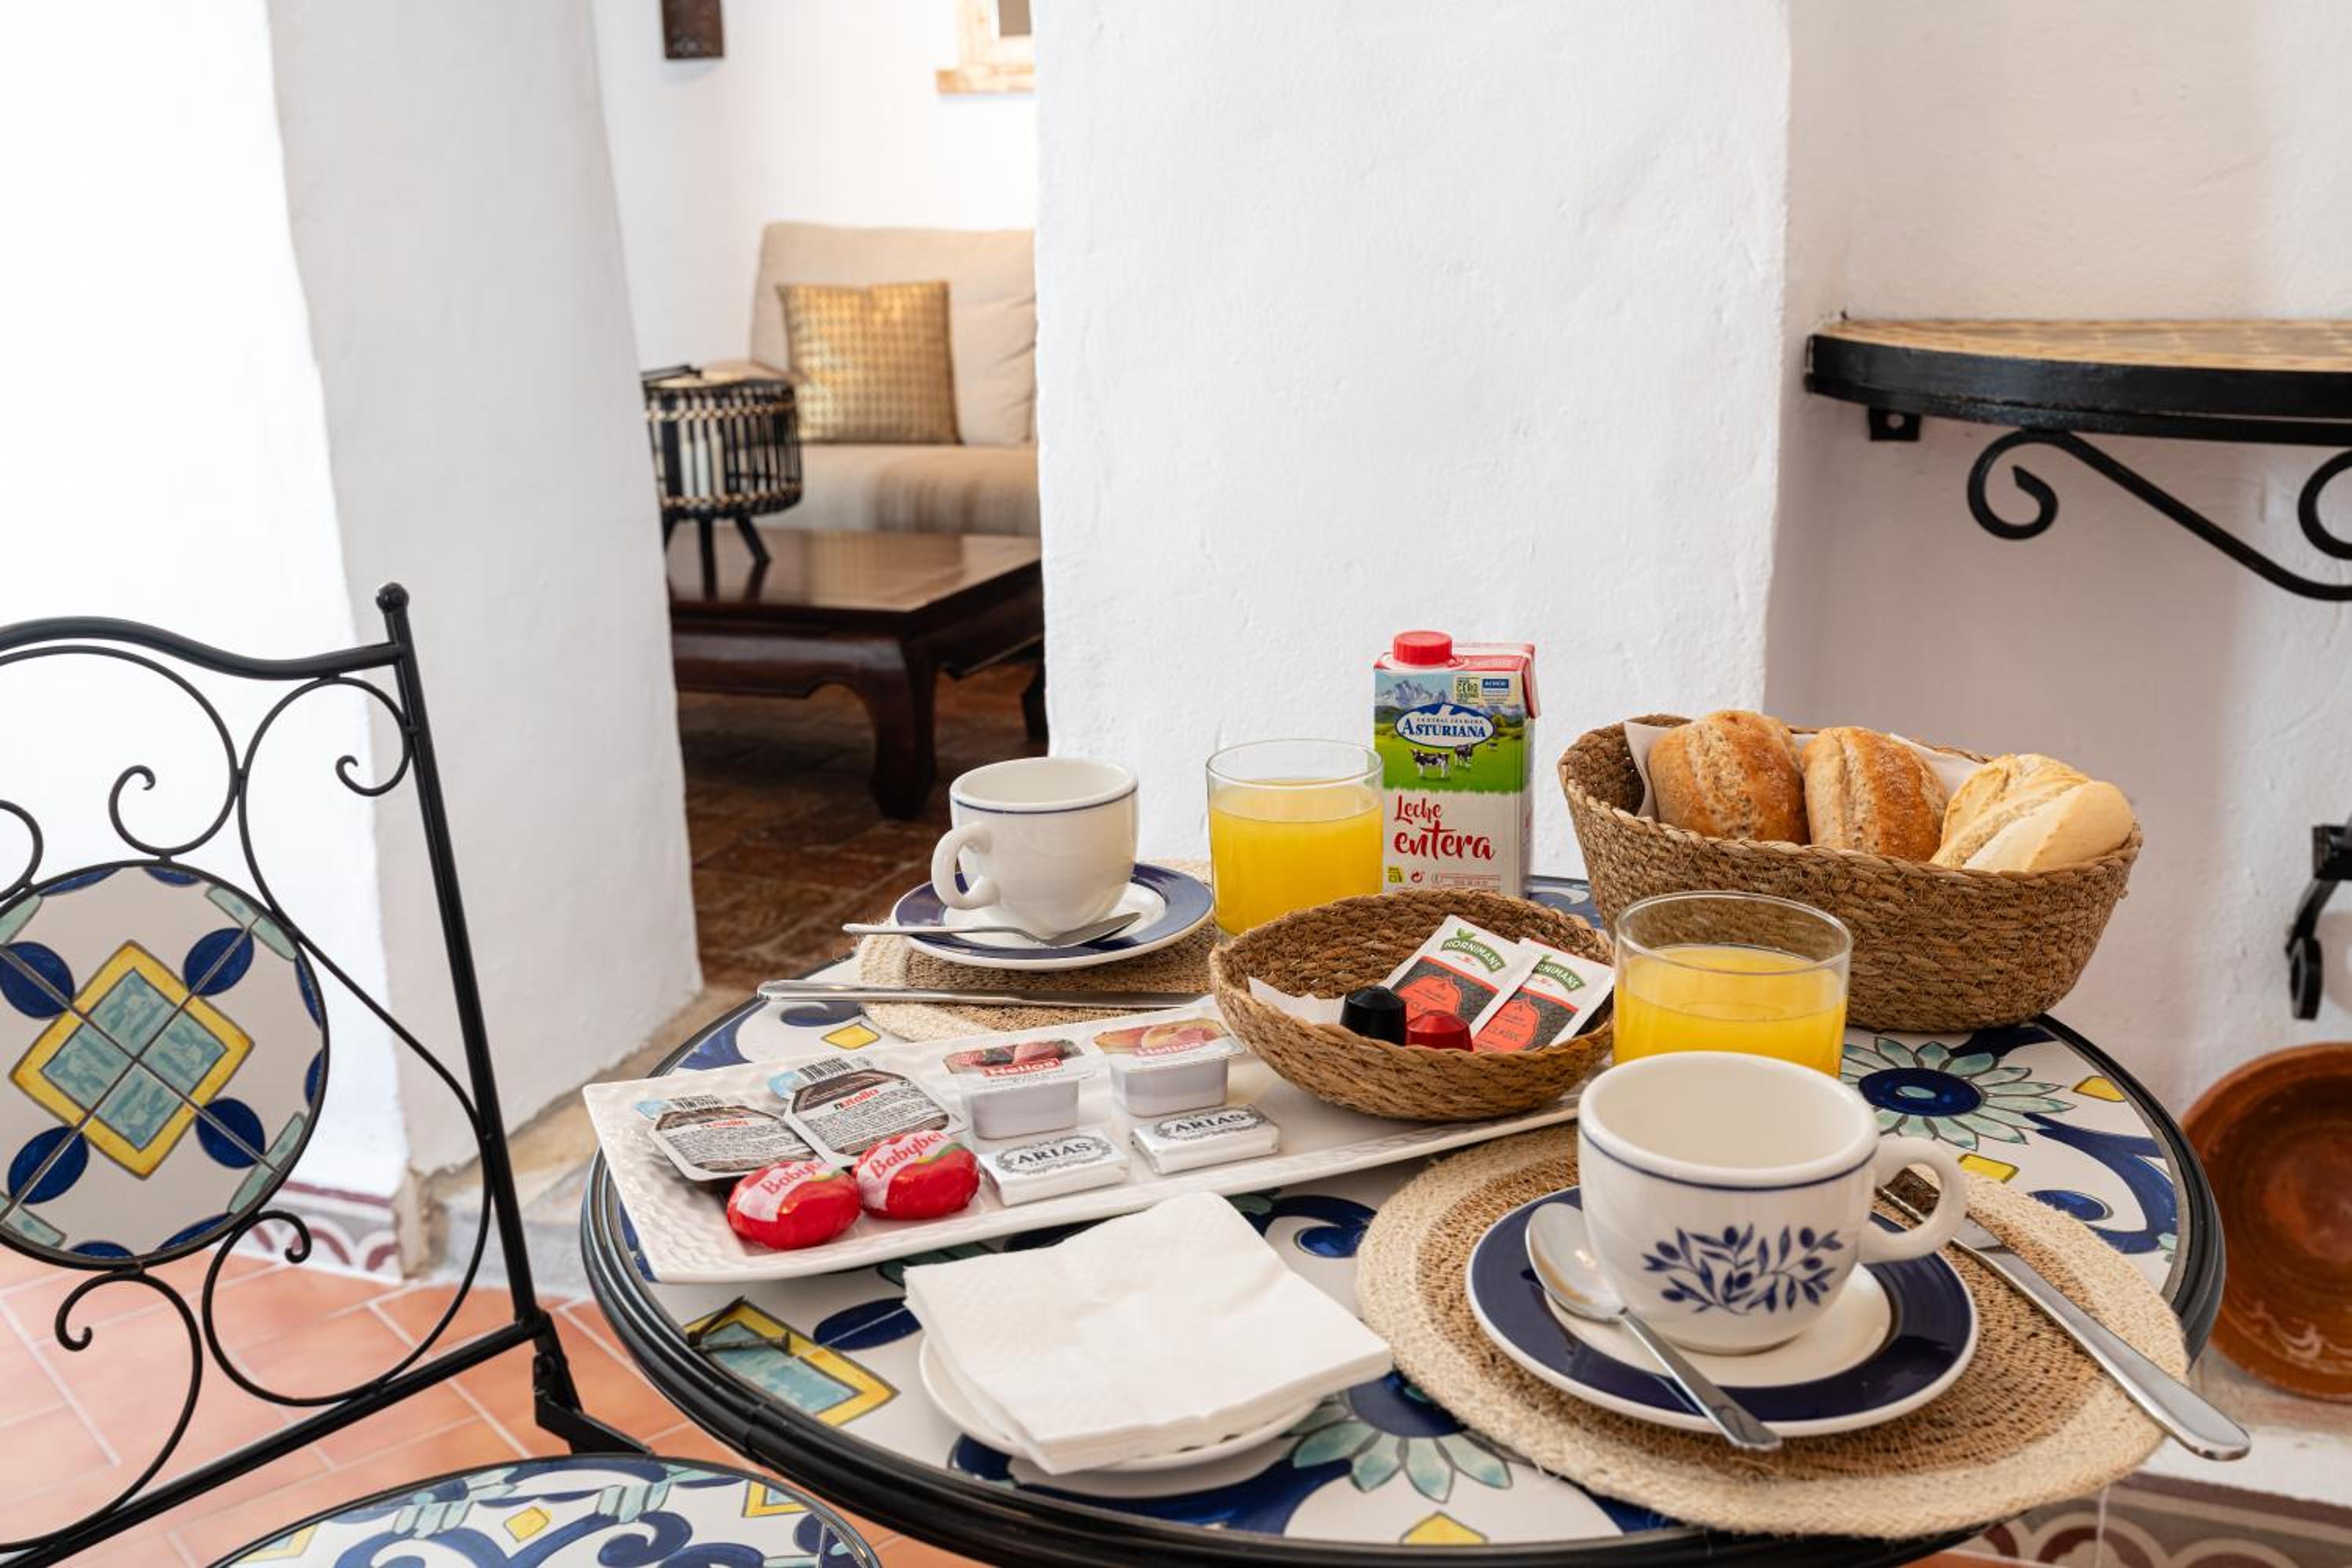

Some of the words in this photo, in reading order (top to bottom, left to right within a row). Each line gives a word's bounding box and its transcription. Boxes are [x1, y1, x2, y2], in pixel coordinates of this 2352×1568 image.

[1402, 717, 1486, 738] ASTURIANA
[1394, 794, 1442, 825] Leche
[1394, 819, 1496, 861] entera
[1443, 939, 1503, 970] HORNIMANS
[1537, 962, 1581, 990] RNIMANS
[1137, 1040, 1200, 1056] Helios
[987, 1060, 1056, 1076] Helios
[1175, 1113, 1246, 1133] ARIAS
[869, 1129, 947, 1179] Babybel
[1018, 1142, 1092, 1165] ARIAS
